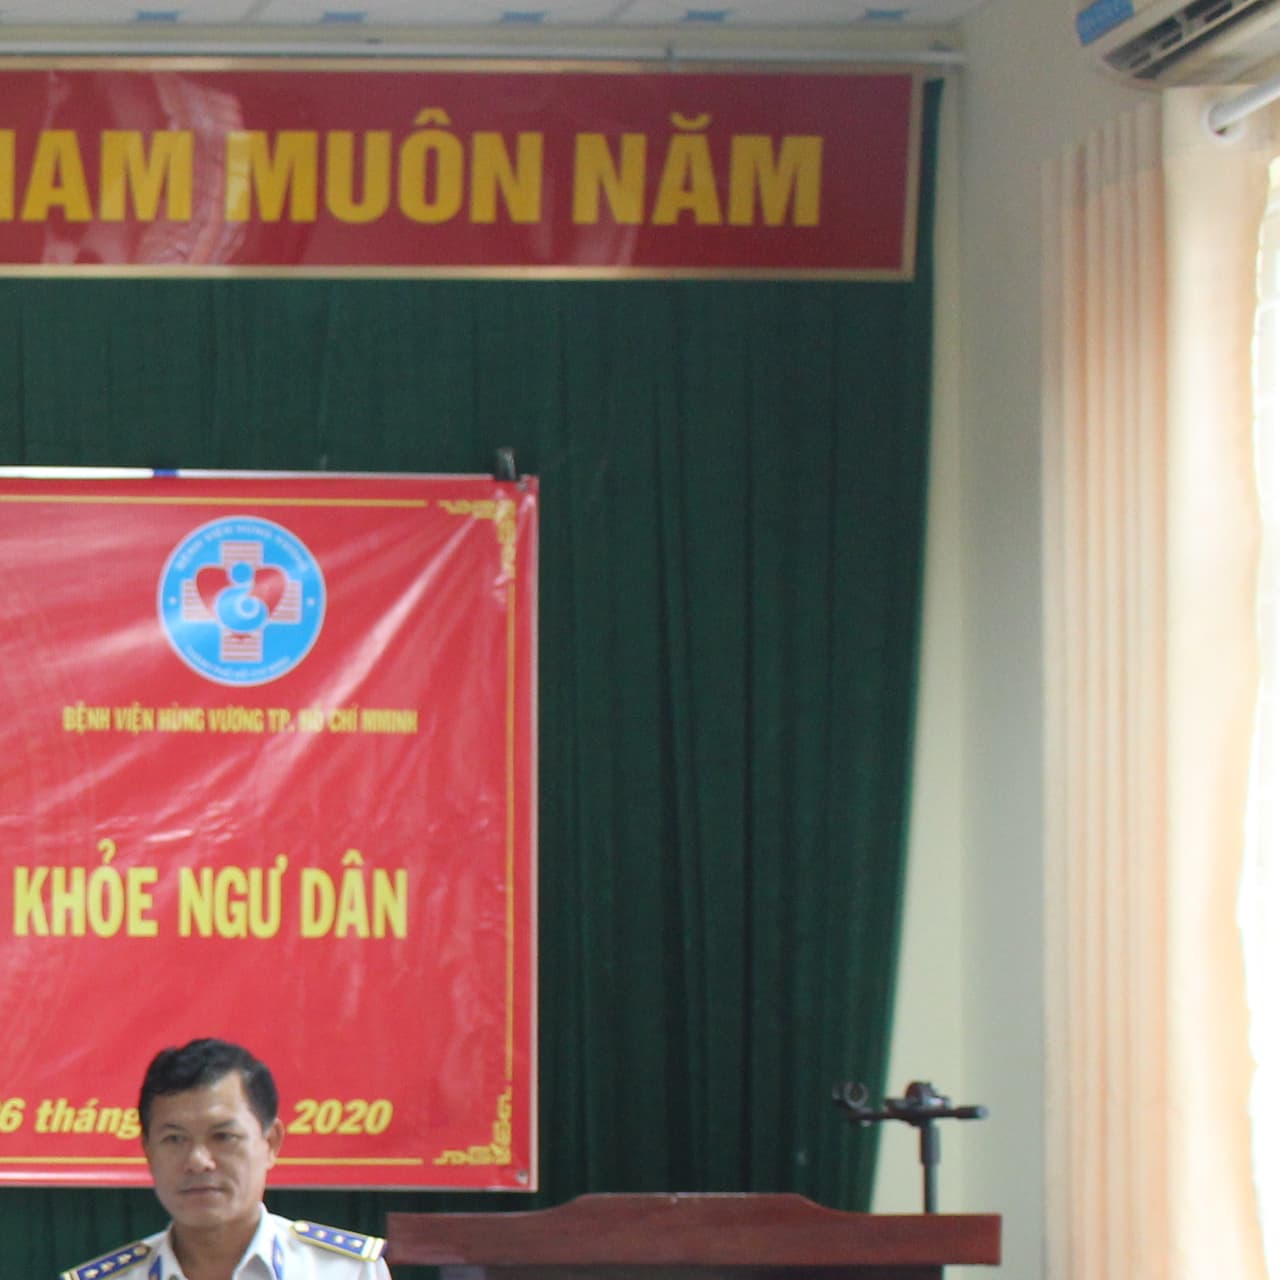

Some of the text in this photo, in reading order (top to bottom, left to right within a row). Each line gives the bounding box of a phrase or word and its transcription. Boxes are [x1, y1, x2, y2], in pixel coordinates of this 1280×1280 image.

[224, 108, 542, 224] MUÔN
[573, 113, 823, 226] NĂM
[62, 701, 111, 735] BỆNH
[114, 701, 155, 735] VIỆN
[157, 703, 205, 732] HÙNG
[14, 839, 158, 938] KHỎE
[179, 855, 288, 939] NGƯ
[300, 849, 408, 939] DÂN
[34, 1098, 143, 1140] tháng
[287, 1099, 393, 1135] 2020
